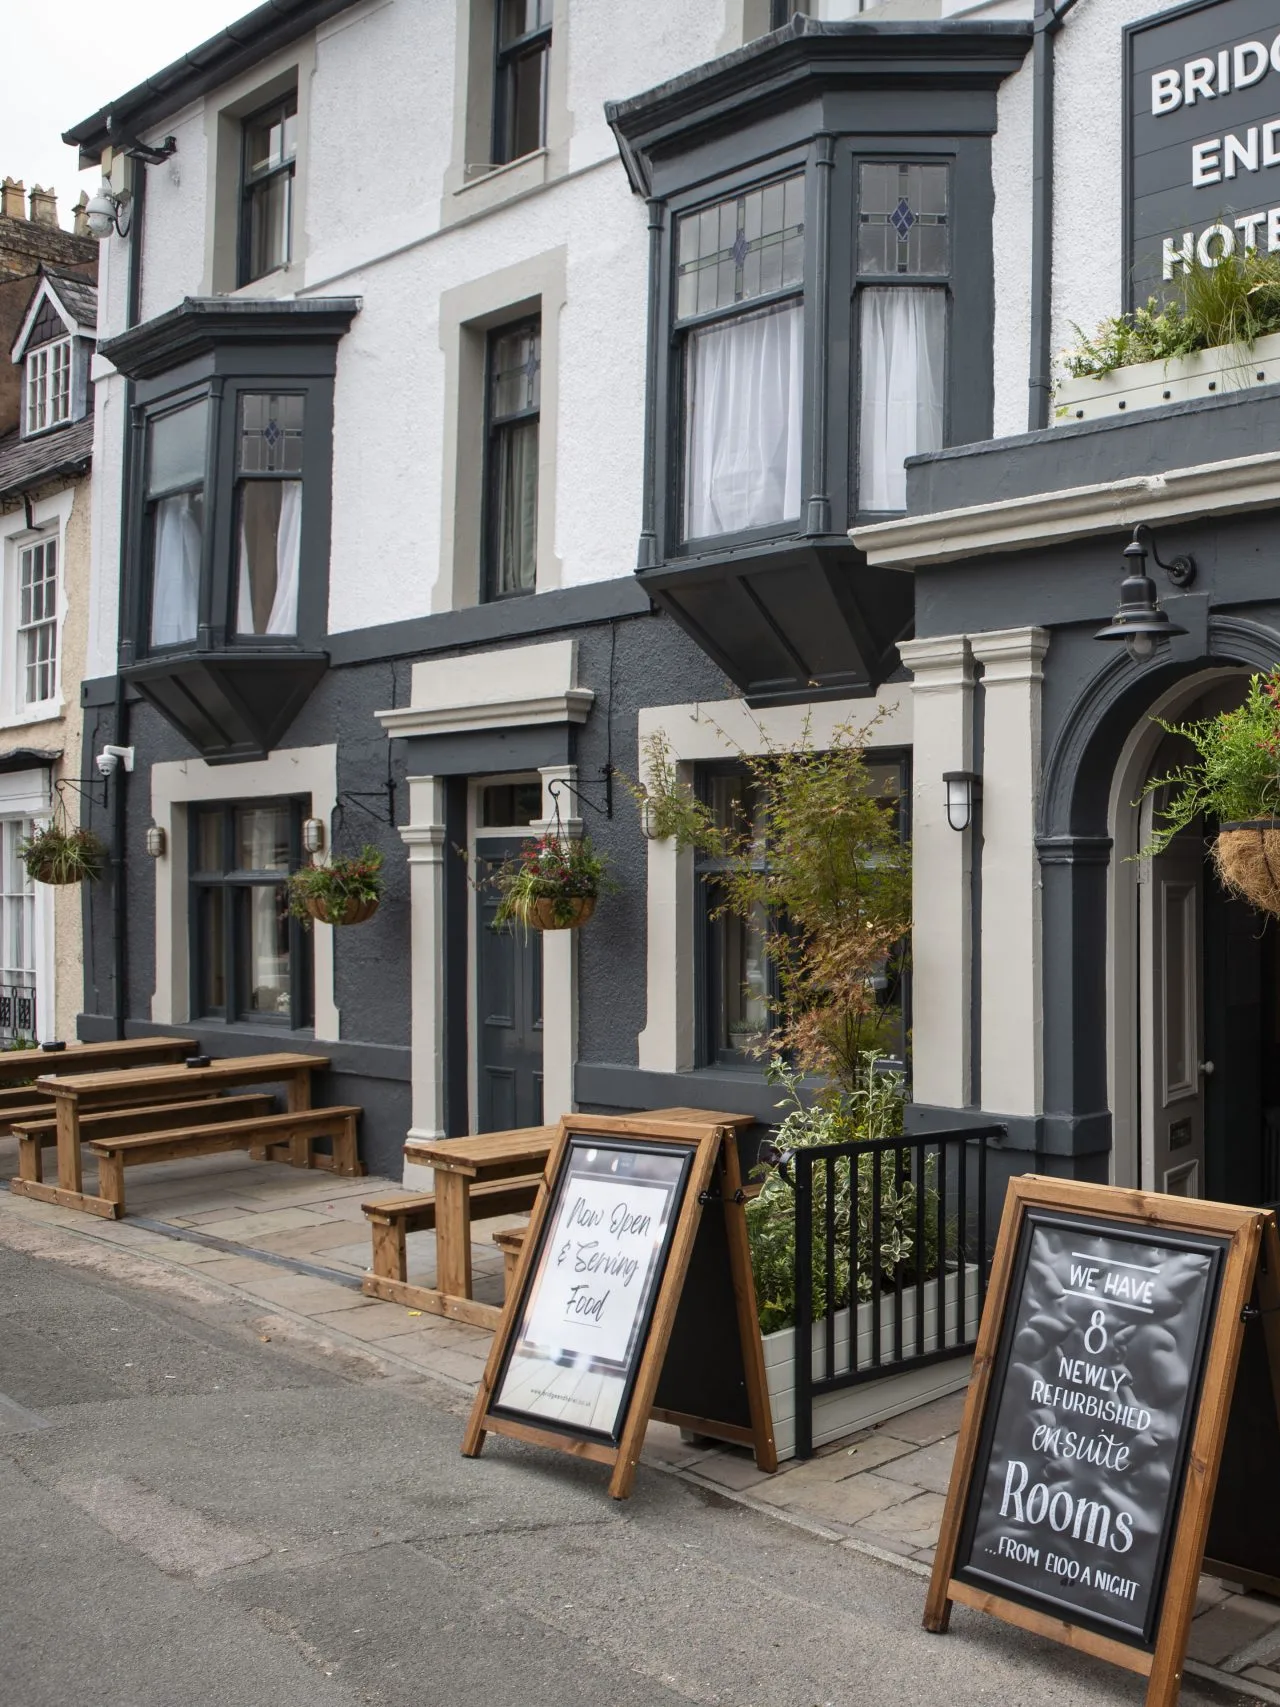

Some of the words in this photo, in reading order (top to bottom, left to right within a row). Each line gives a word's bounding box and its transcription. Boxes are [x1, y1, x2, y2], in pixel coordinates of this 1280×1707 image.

[566, 1197, 605, 1229] Now
[609, 1202, 651, 1240] Open
[557, 1239, 571, 1267] &
[574, 1240, 639, 1288] Serving
[1070, 1264, 1100, 1292] WE
[1104, 1272, 1155, 1304] HAVE
[566, 1284, 611, 1322] Food
[1084, 1309, 1108, 1355] 8
[1058, 1357, 1127, 1393] NEWLY
[1031, 1380, 1152, 1431] REFURBISHED
[1031, 1424, 1131, 1472] en-suite
[998, 1460, 1134, 1553] Rooms
[1080, 1566, 1091, 1587] A
[1094, 1569, 1141, 1602] NIGHT
